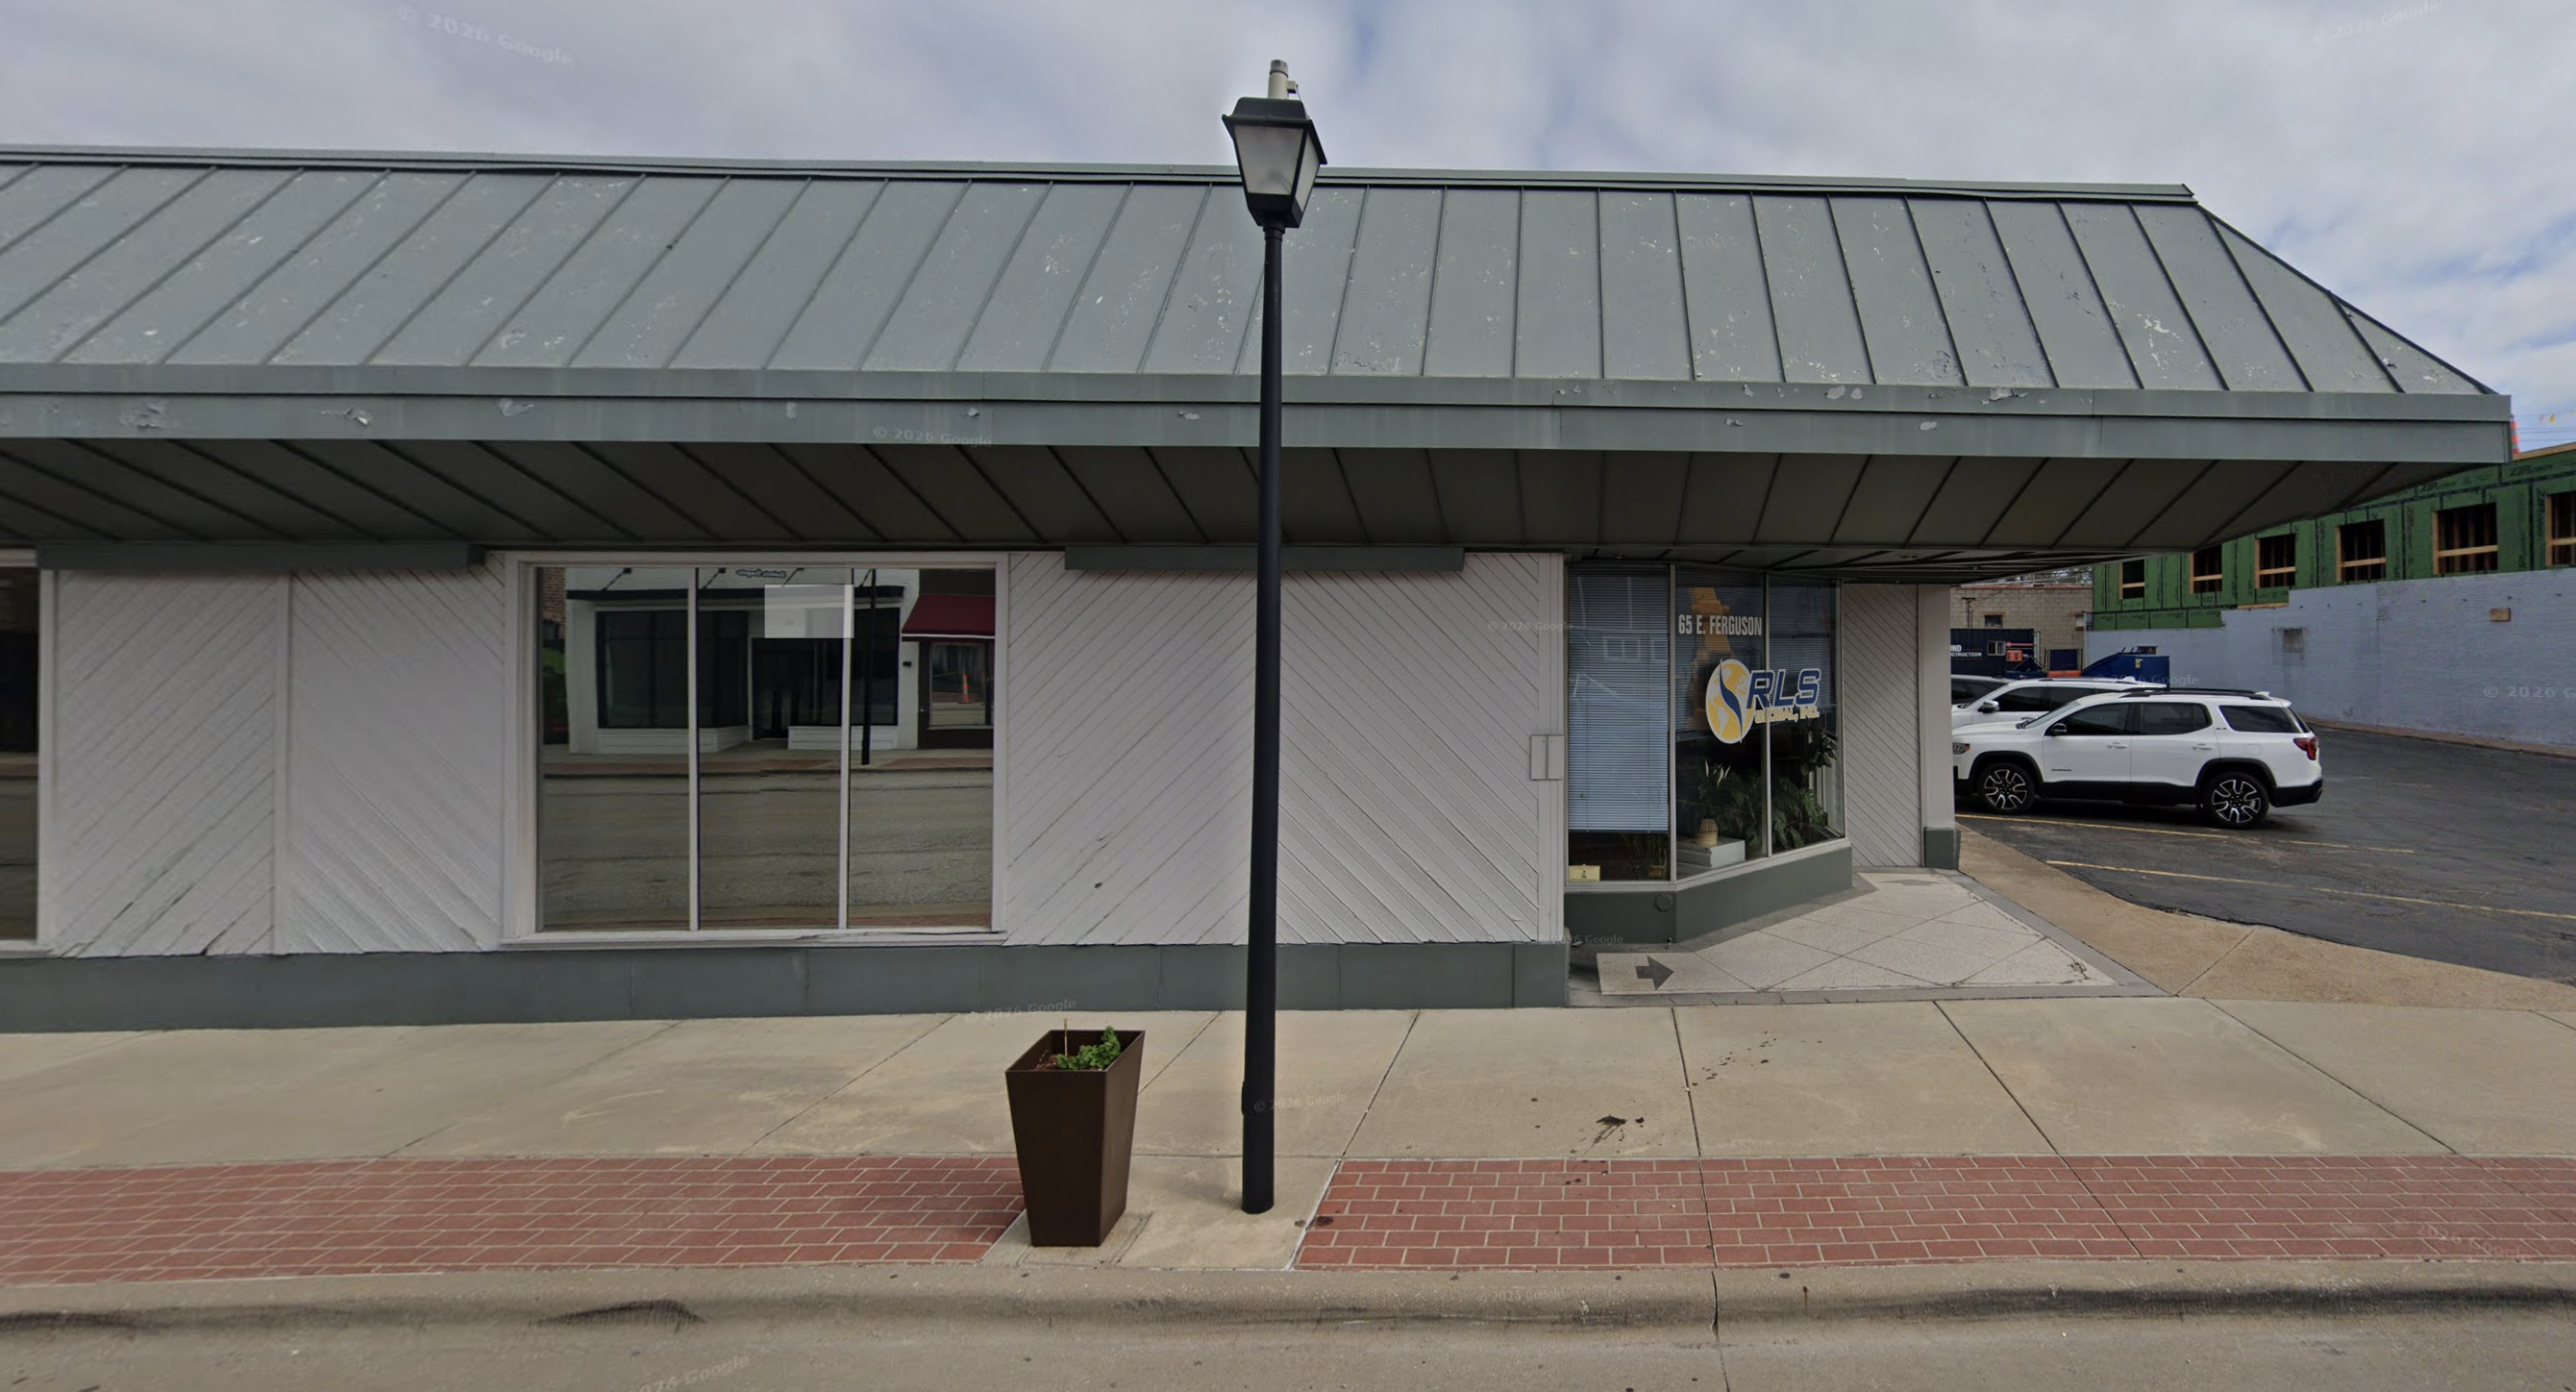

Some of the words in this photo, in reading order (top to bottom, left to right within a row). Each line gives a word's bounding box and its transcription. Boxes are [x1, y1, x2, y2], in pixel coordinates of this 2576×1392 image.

[1678, 614, 1693, 634] 65
[1697, 614, 1706, 634] E.
[1710, 615, 1762, 635] FERGUSON
[1746, 667, 1821, 709] RLS
[1754, 706, 1798, 724] GLOBAL,
[1800, 705, 1821, 720] INC.
